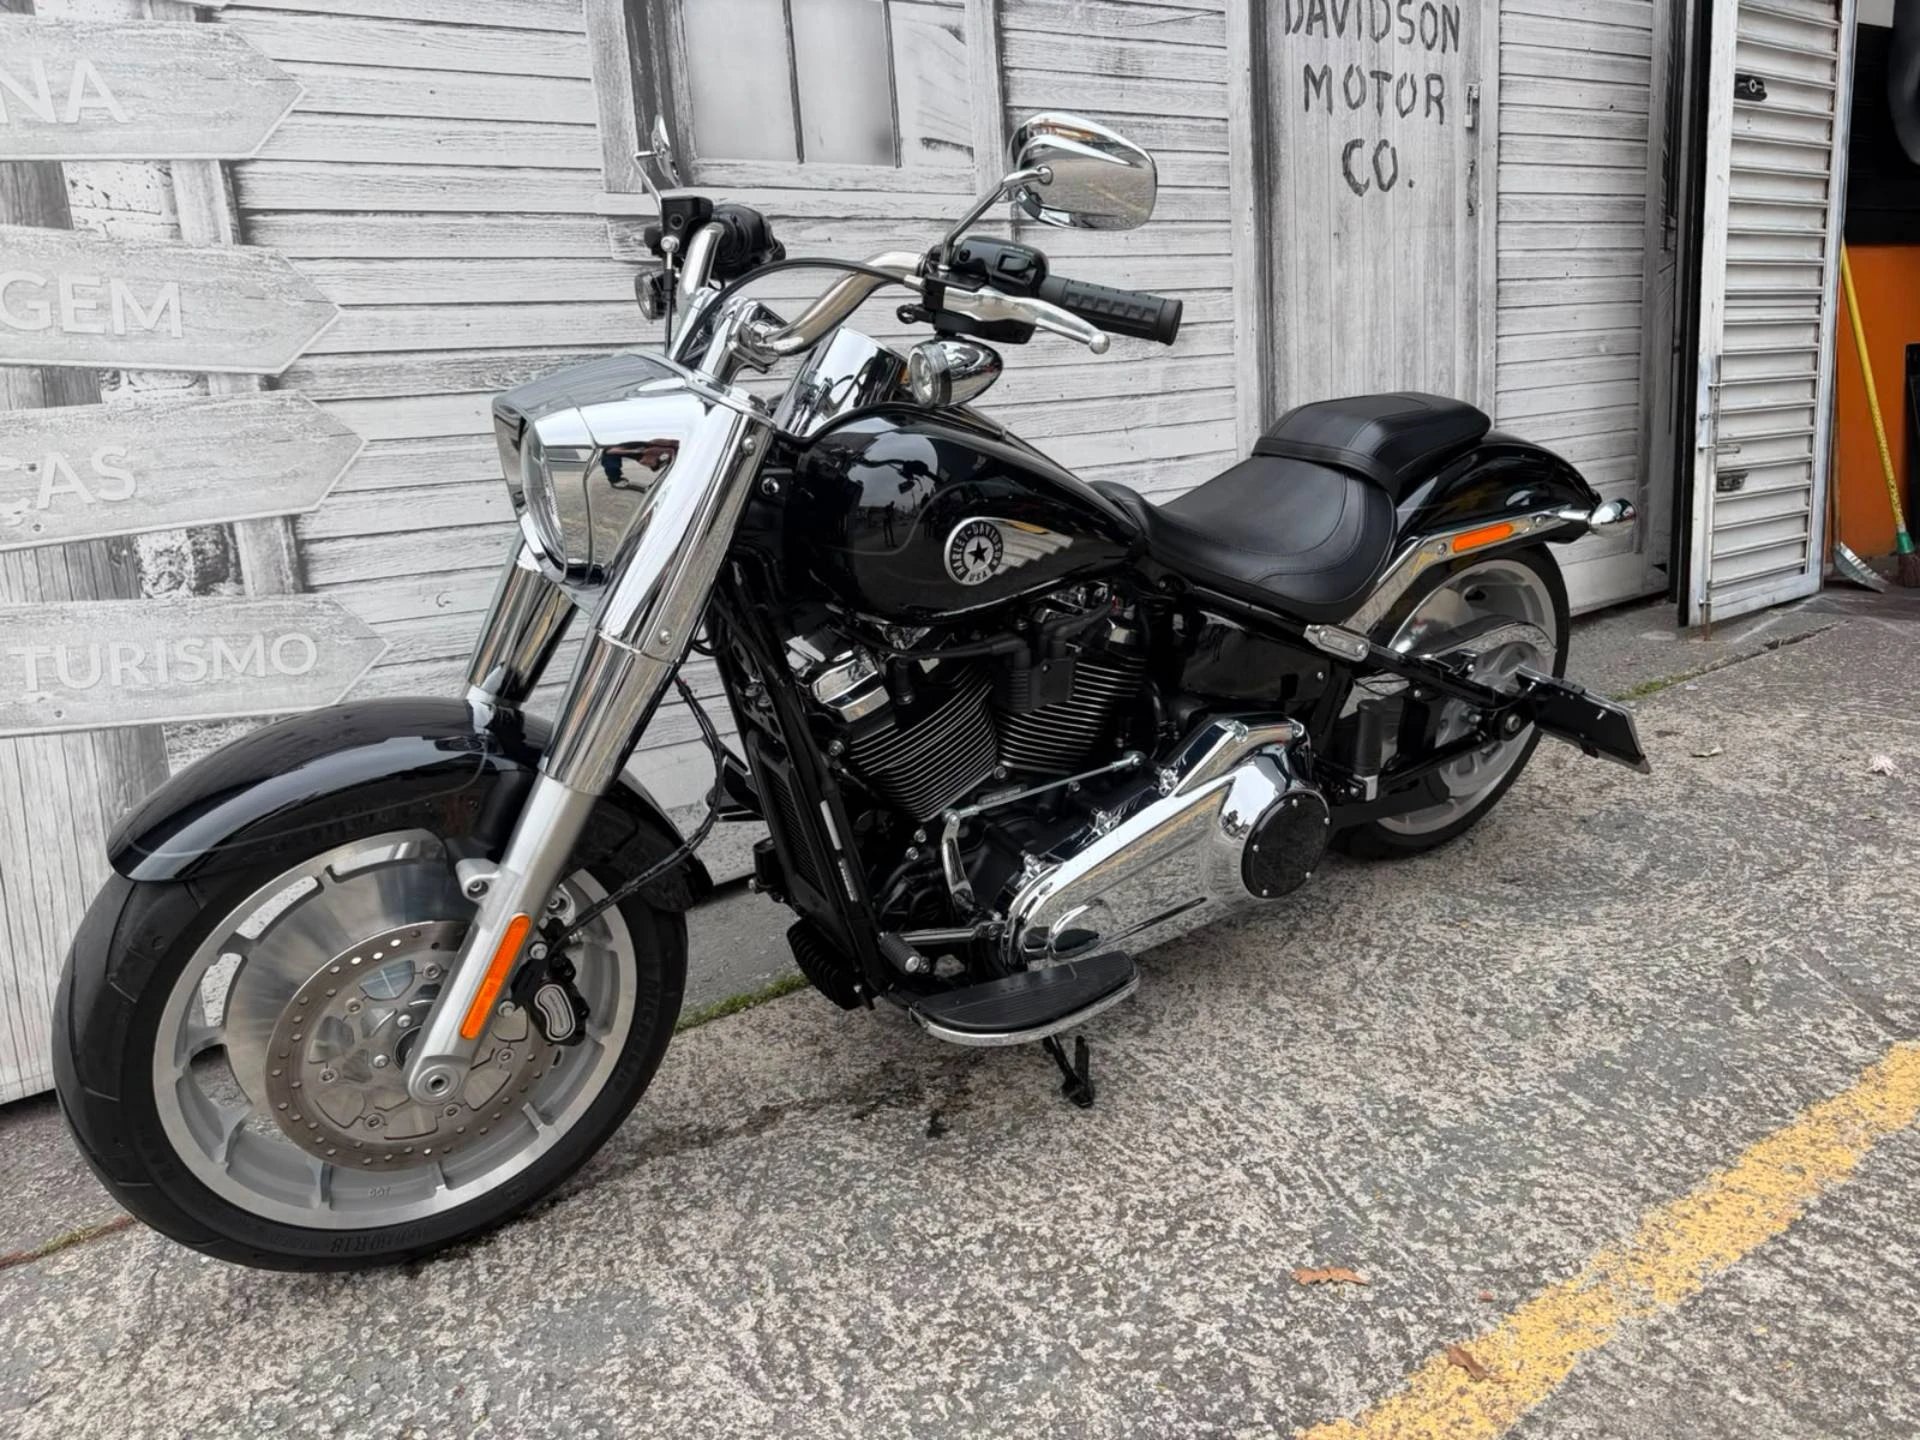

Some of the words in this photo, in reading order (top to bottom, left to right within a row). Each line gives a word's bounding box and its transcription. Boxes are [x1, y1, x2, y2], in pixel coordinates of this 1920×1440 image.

[1285, 0, 1460, 53] DAVIDSON
[1304, 63, 1445, 125] MOTOR
[1342, 138, 1415, 197] CO.
[1, 271, 184, 339] GEM
[967, 570, 988, 582] USA
[7, 632, 318, 692] TURISMO
